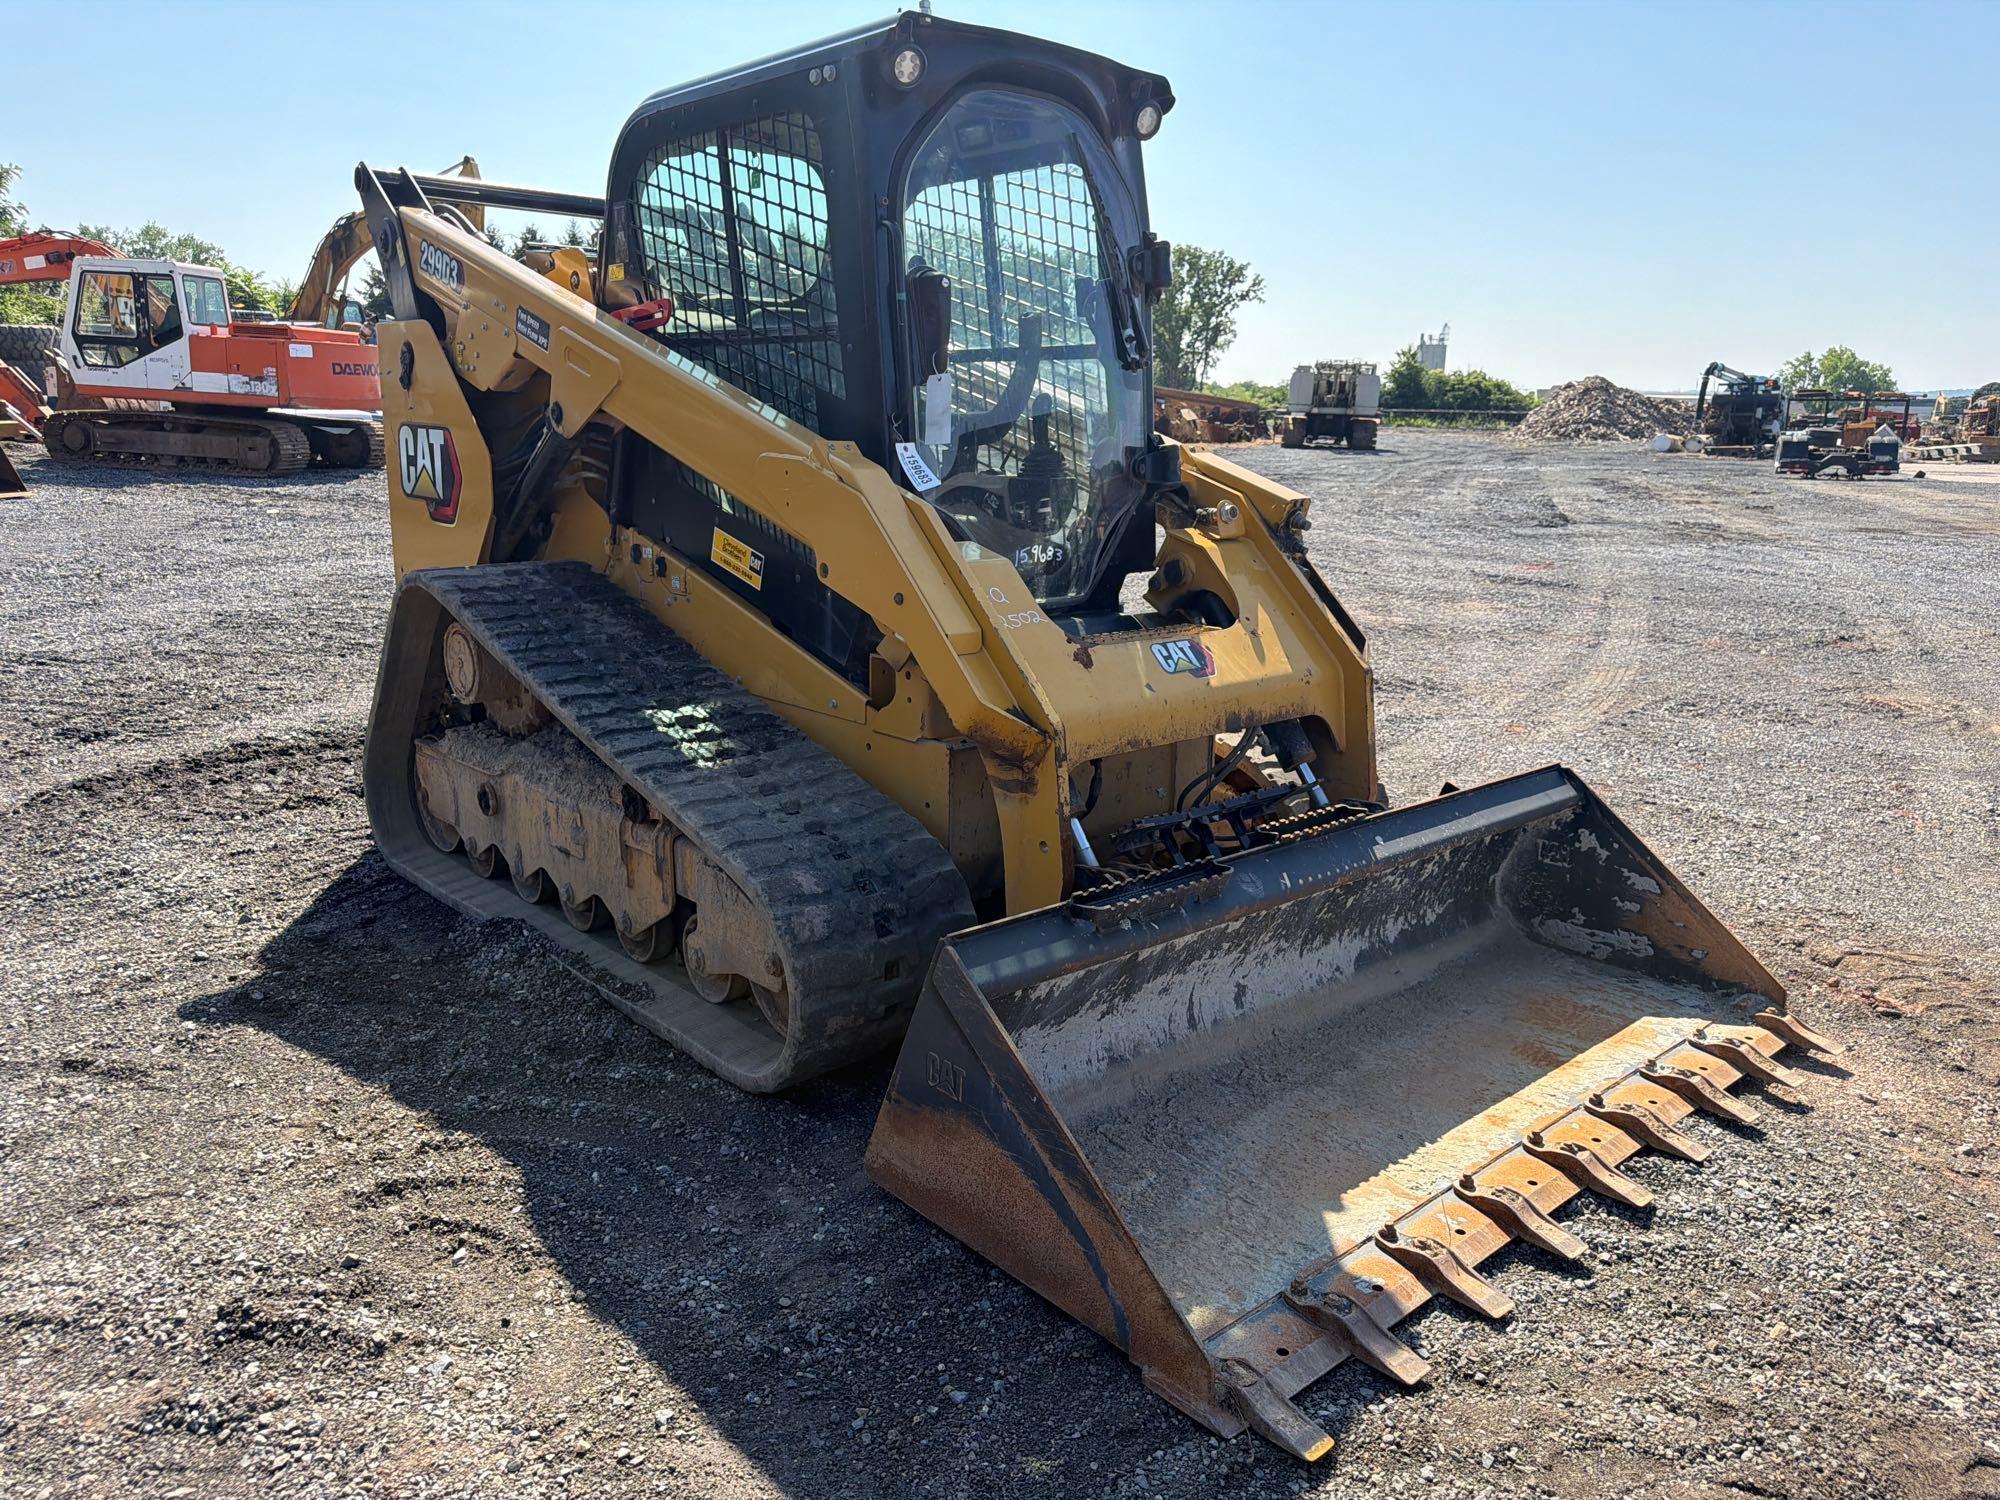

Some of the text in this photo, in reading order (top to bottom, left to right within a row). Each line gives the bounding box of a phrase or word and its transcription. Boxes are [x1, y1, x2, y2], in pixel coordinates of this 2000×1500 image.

[420, 241, 459, 289] 299D3
[332, 361, 379, 377] DAEWO
[399, 424, 445, 500] CAT
[905, 453, 932, 485] 159683
[750, 555, 762, 572] CAT
[1014, 544, 1063, 567] 159683
[1151, 640, 1202, 674] CAT
[927, 1051, 966, 1103] CAT
